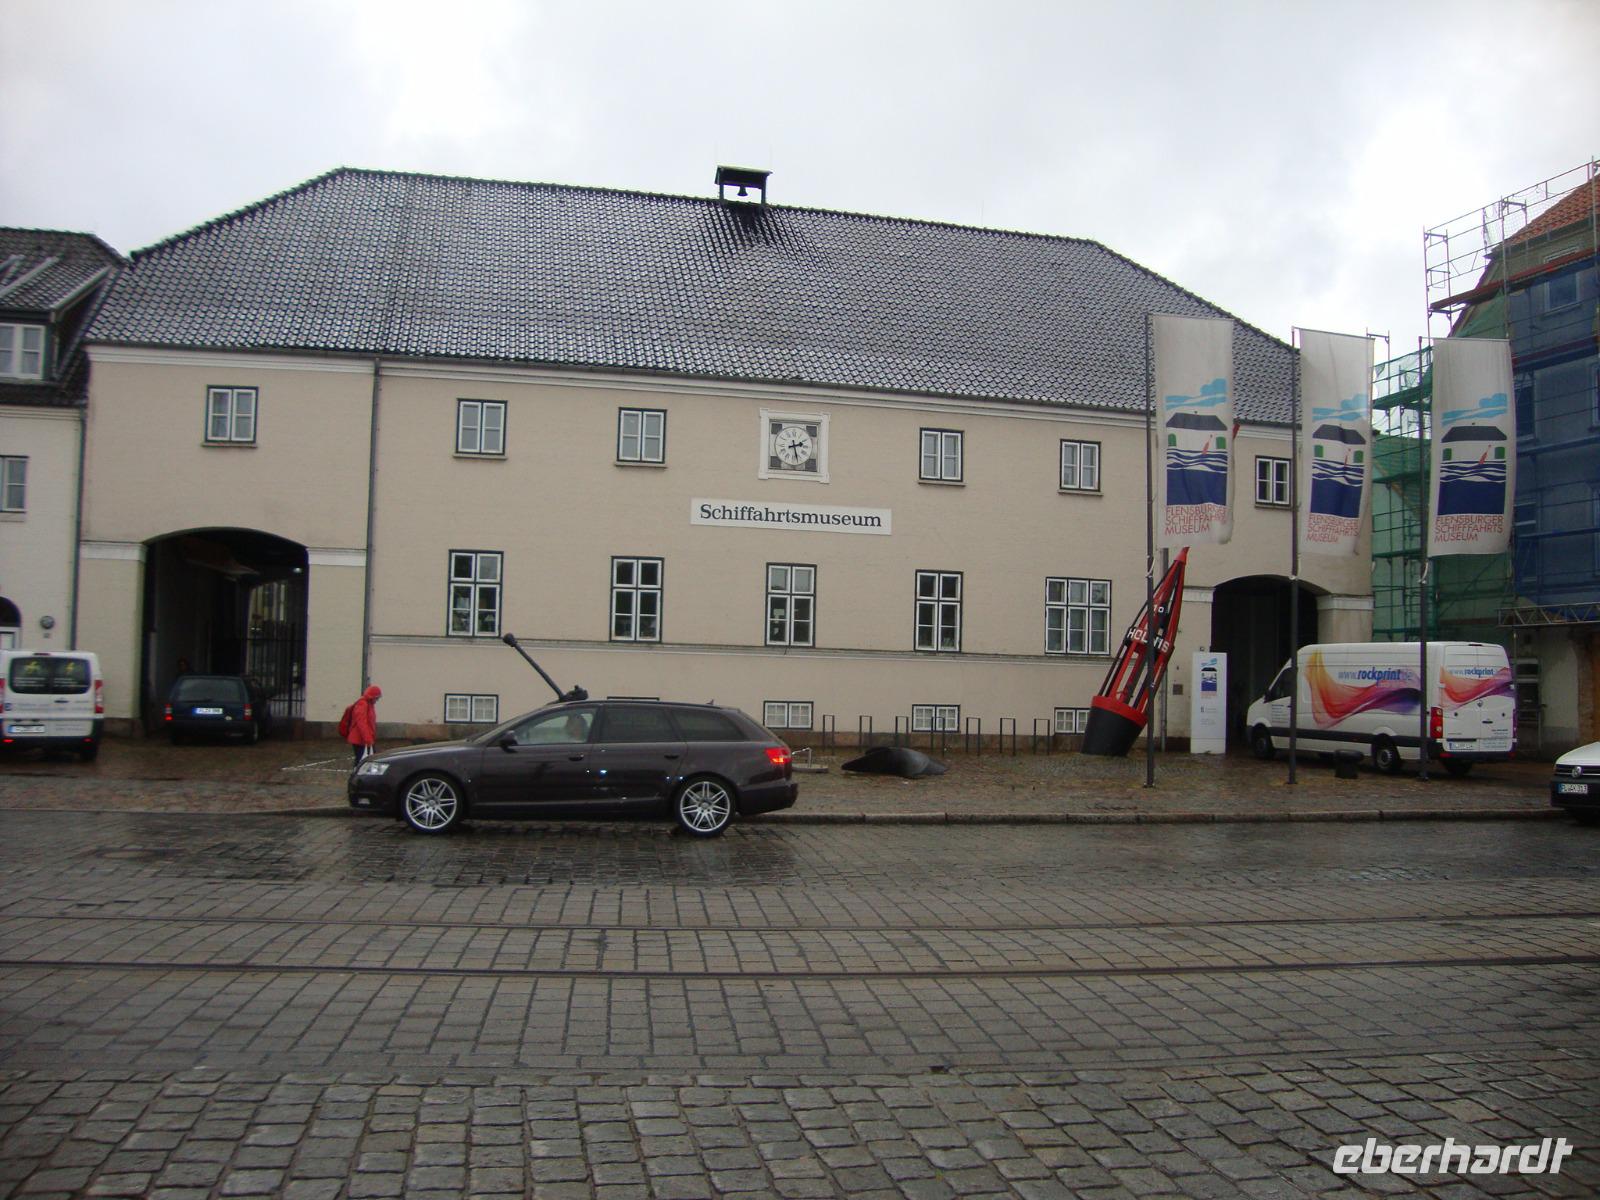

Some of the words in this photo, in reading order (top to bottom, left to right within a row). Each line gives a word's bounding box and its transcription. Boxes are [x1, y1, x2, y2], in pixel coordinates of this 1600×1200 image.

[700, 503, 882, 527] Schiffahrtsmuseum
[1436, 515, 1504, 525] FLENSBURGER
[1165, 524, 1210, 535] MUSEUM
[1434, 532, 1479, 543] MUSEUM
